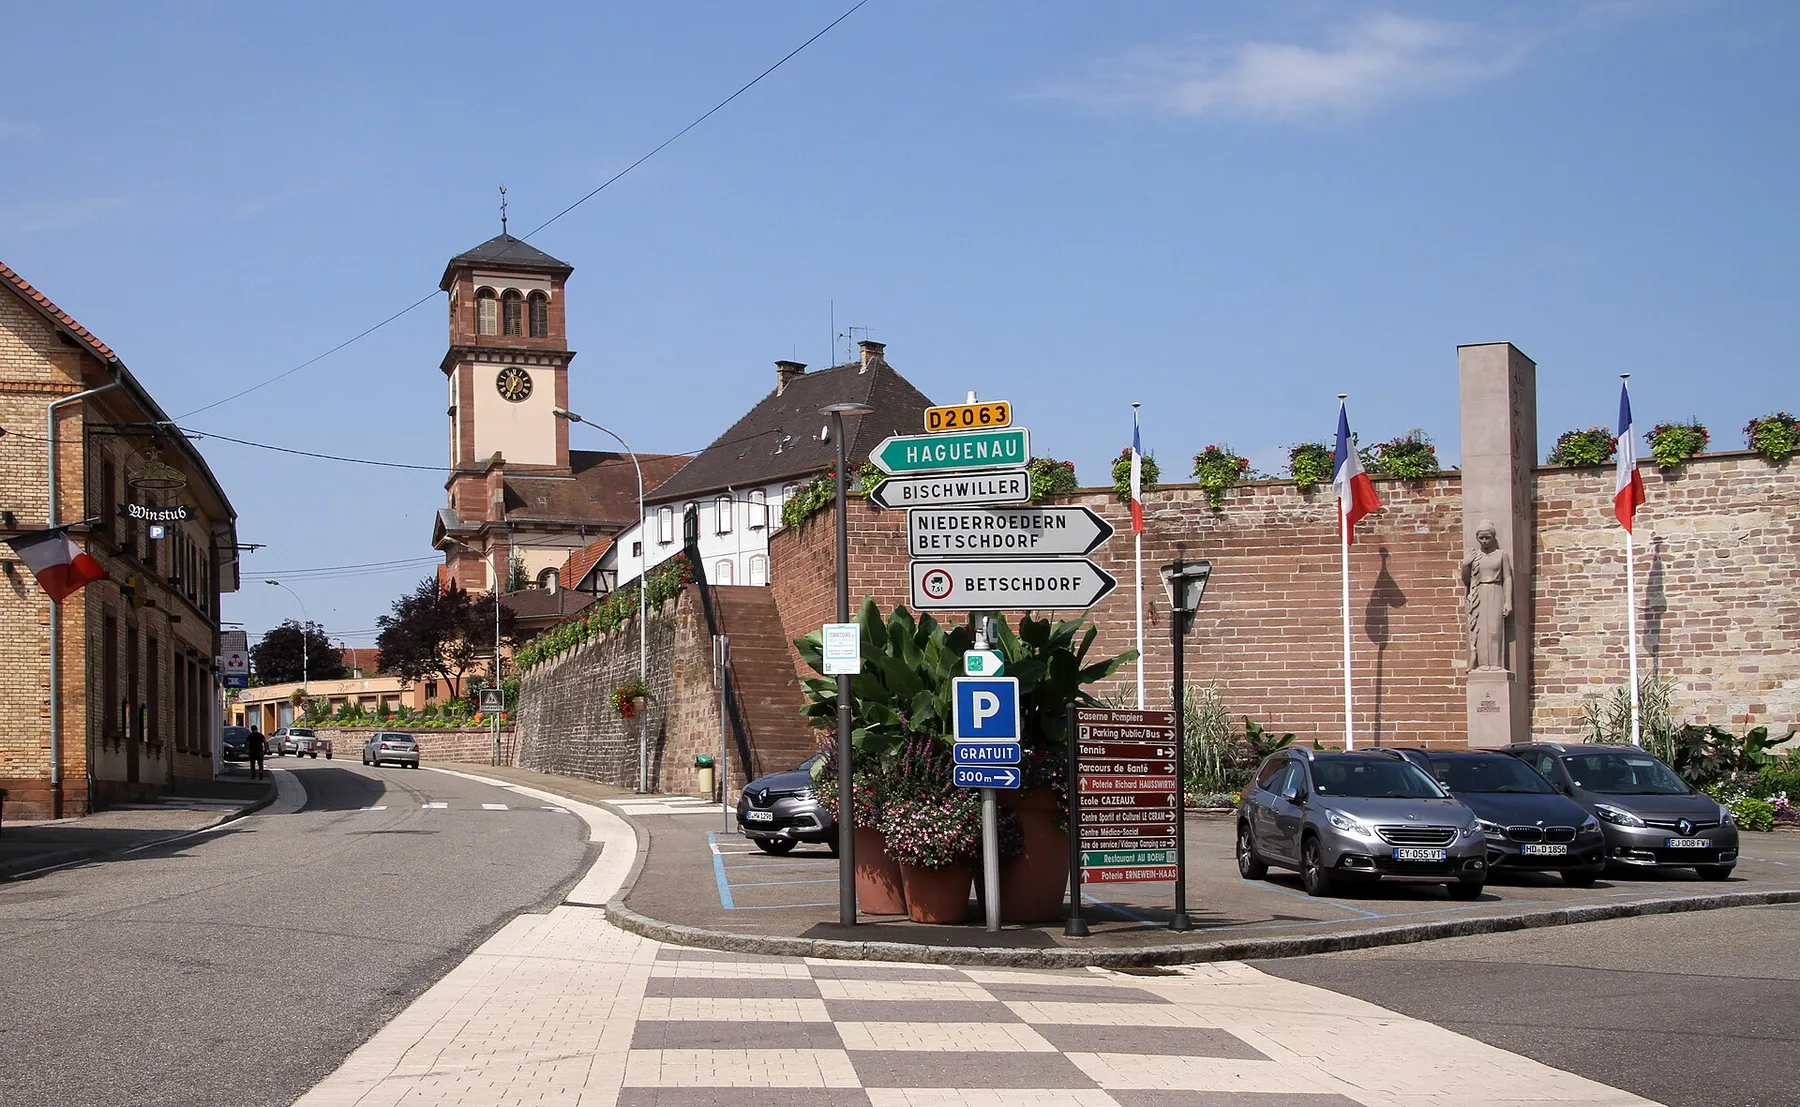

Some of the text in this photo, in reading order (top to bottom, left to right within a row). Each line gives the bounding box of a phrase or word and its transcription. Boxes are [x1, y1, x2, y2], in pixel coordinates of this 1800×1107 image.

[929, 406, 1006, 428] D2063
[906, 439, 1017, 463] HAGUENAU
[903, 479, 1020, 500] BISCHWILLER
[128, 503, 187, 520] Winstub
[918, 515, 1066, 530] NIEDERROEDERN
[918, 534, 1040, 548] BETSCHDORF
[965, 577, 1082, 592] BETSCHDORF
[973, 691, 999, 728] P
[1078, 711, 1144, 722] Caserne Pompiers
[1092, 728, 1119, 739] Parking
[960, 747, 1014, 759] GRATUIT
[1079, 745, 1106, 755] Tennis
[1078, 763, 1148, 773] Parcours de Santé
[1092, 780, 1113, 789] Poterie
[1114, 780, 1137, 789] Richard
[1080, 796, 1136, 806] Ecole CAZEAUX
[1081, 813, 1098, 822] Centre
[1098, 812, 1115, 823] Sportif
[1115, 813, 1121, 821] et
[1122, 812, 1141, 821] Culturel
[1141, 812, 1148, 821] LE
[1080, 827, 1139, 837] Centre Médico-Social
[1080, 841, 1091, 849] Aire
[1091, 841, 1099, 849] de
[1139, 840, 1158, 850] Camping
[1103, 854, 1136, 863] Restaurant
[1137, 853, 1146, 862] AU
[1101, 871, 1123, 880] Poterie
